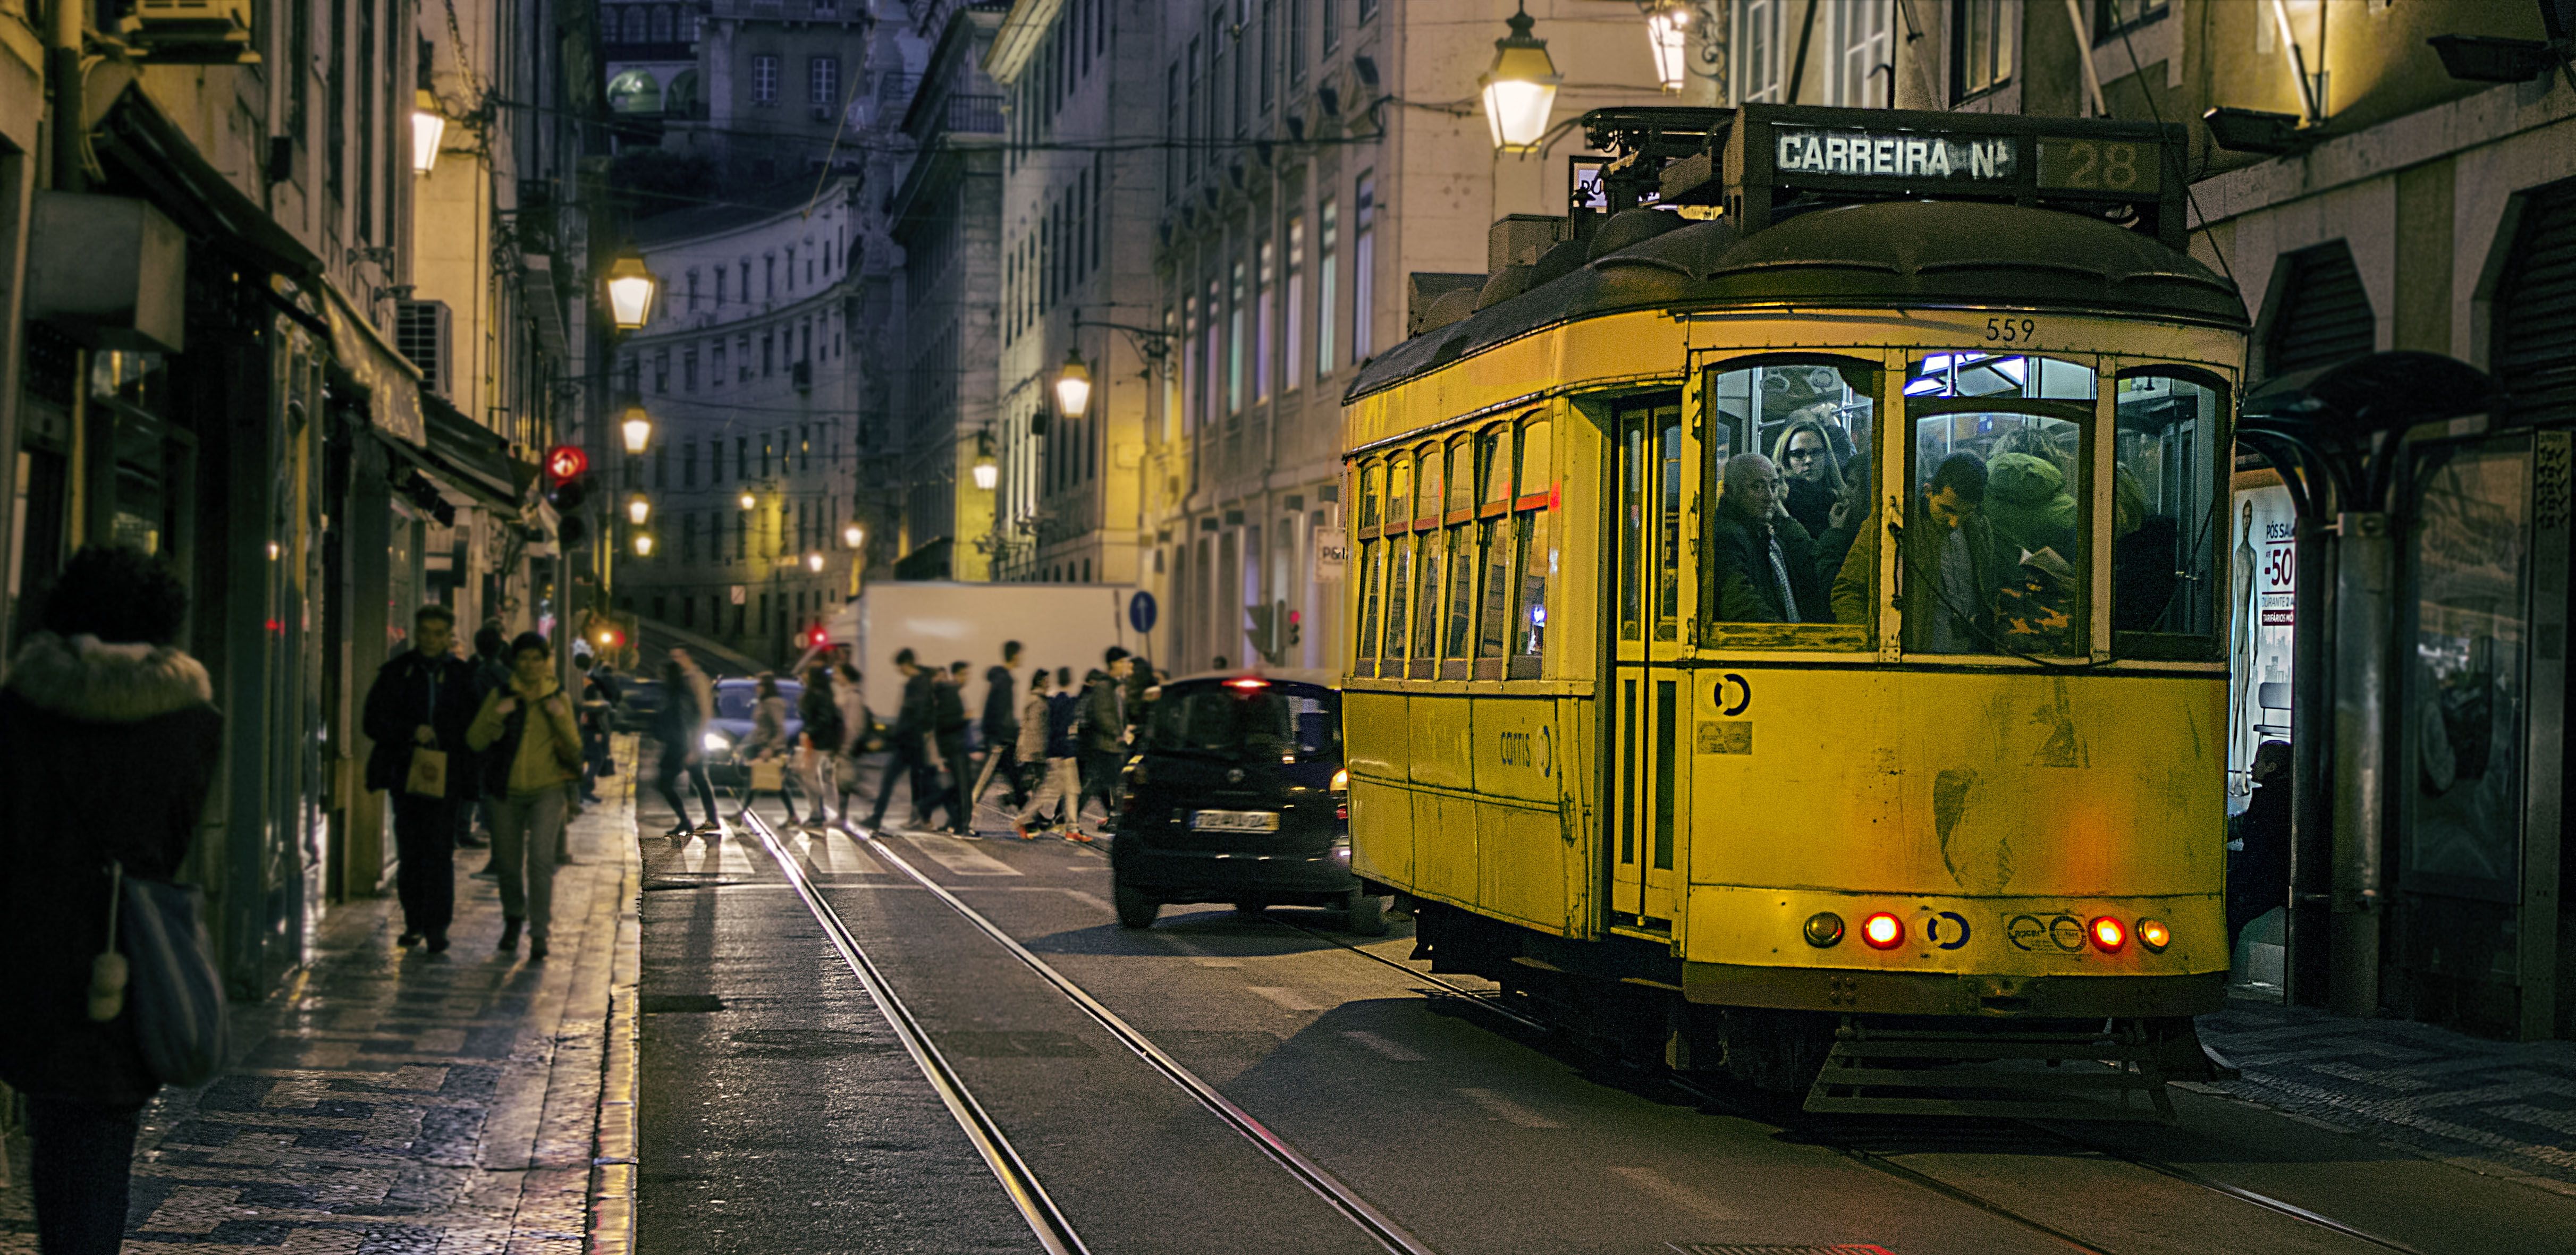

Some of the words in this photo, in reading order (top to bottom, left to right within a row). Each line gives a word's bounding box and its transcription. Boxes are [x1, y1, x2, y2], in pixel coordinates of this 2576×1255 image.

[1779, 136, 1951, 176] CARREIRA
[2066, 141, 2137, 189] 28
[1986, 318, 2035, 342] 559
[2266, 520, 2278, 539] PÓS
[2262, 596, 2285, 608] DURANTE
[1500, 731, 1531, 767] carris
